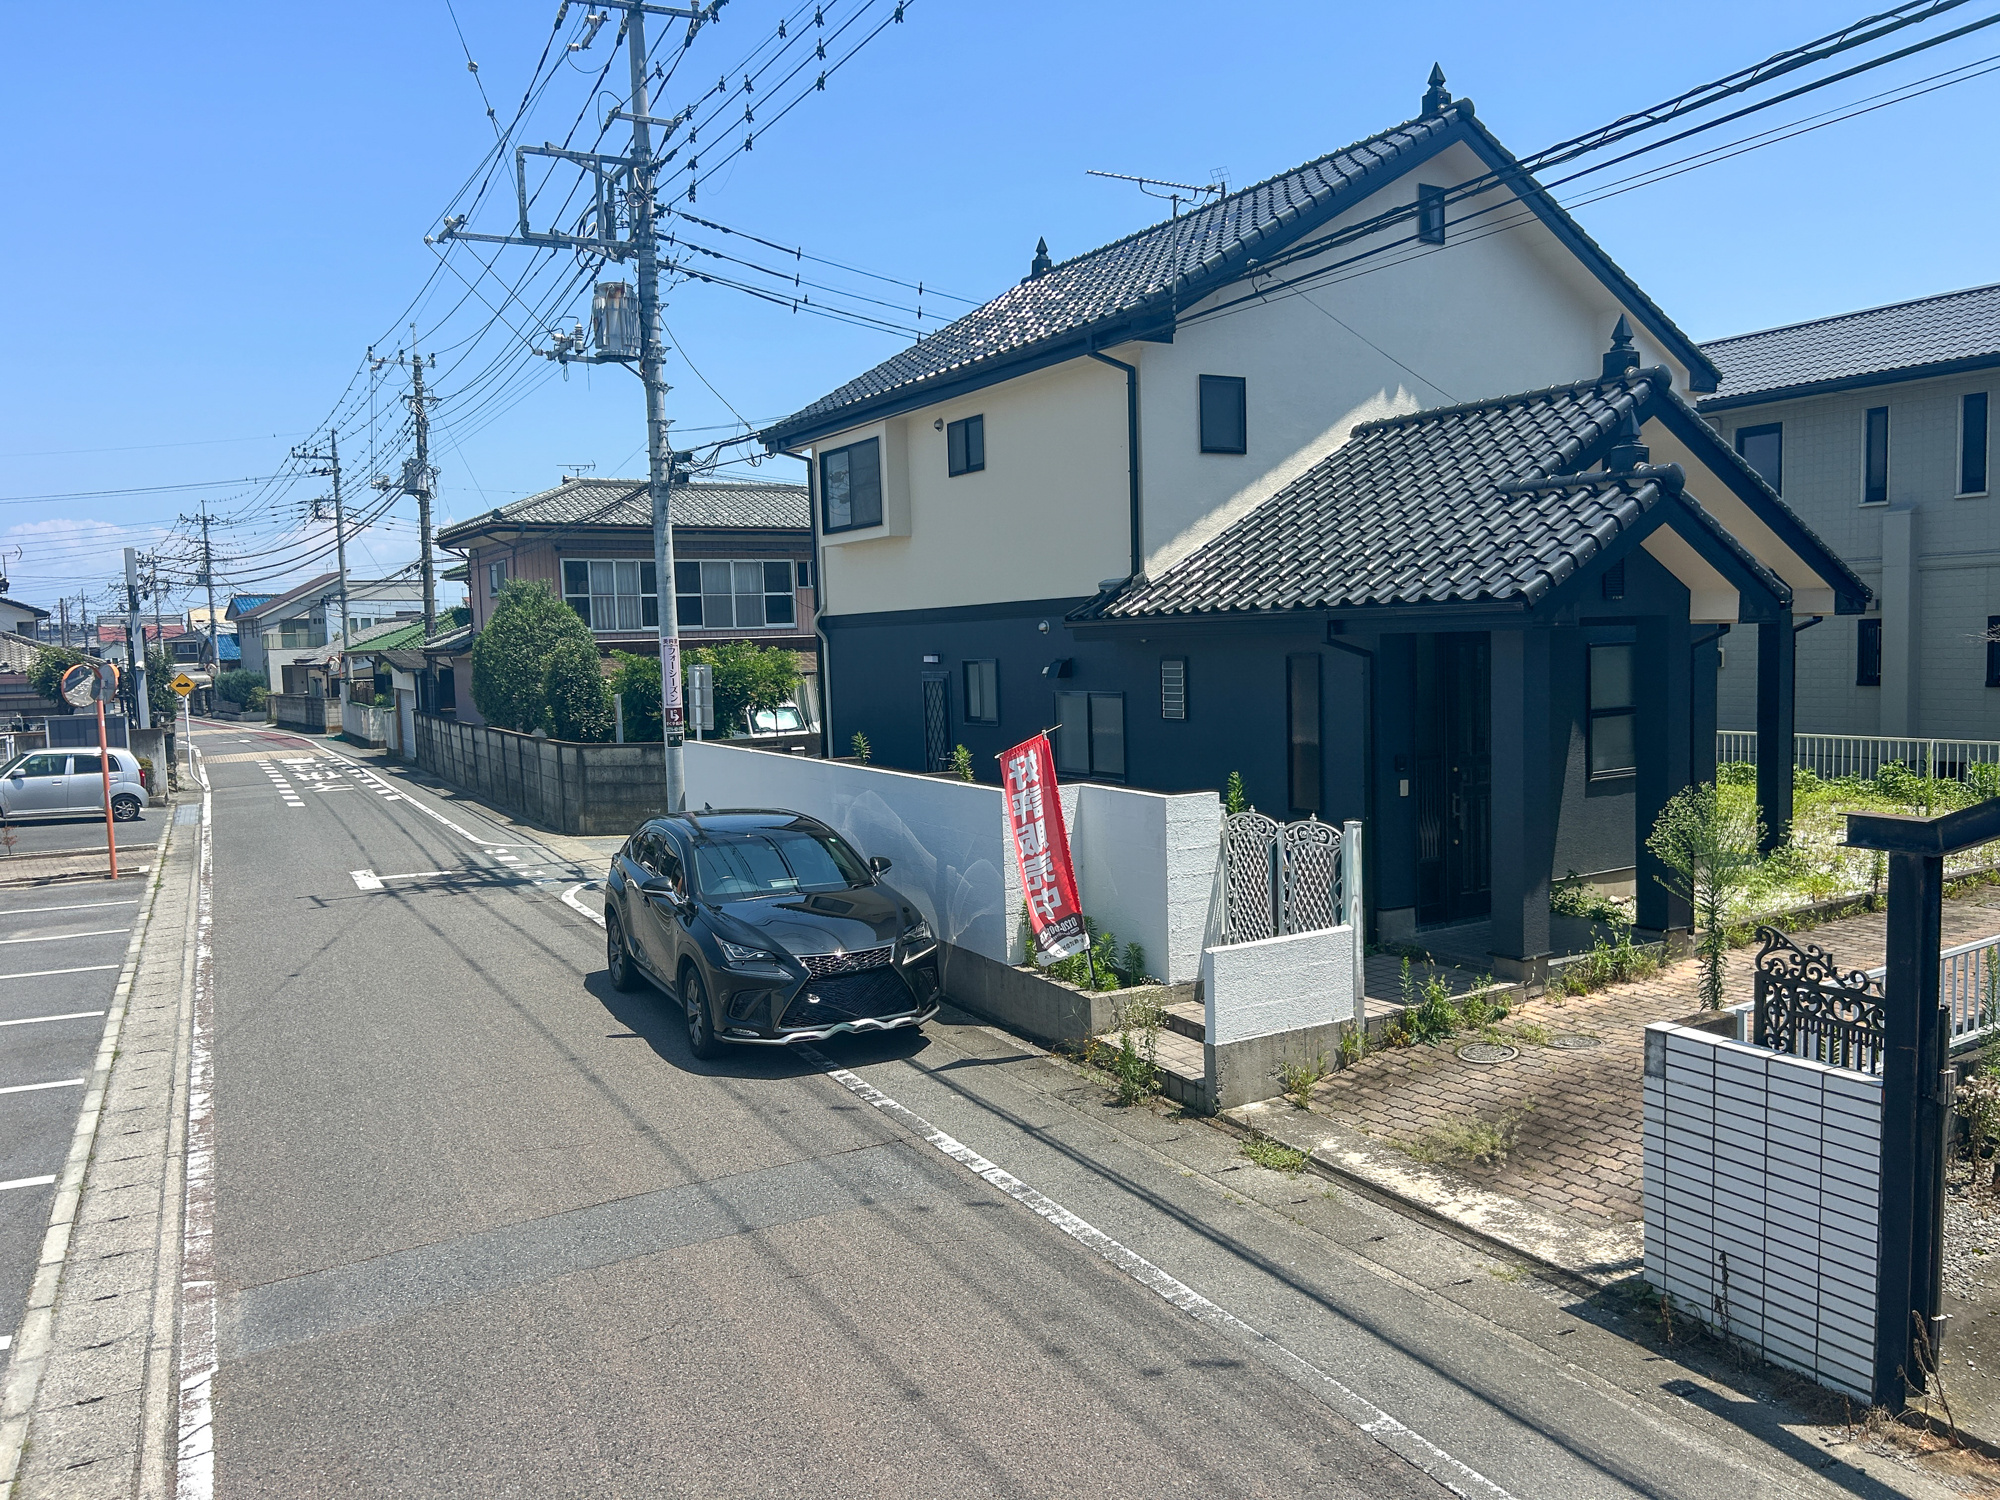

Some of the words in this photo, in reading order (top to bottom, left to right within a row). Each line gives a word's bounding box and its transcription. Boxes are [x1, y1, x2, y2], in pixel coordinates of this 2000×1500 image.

[668, 647, 679, 703] フォーシーズン
